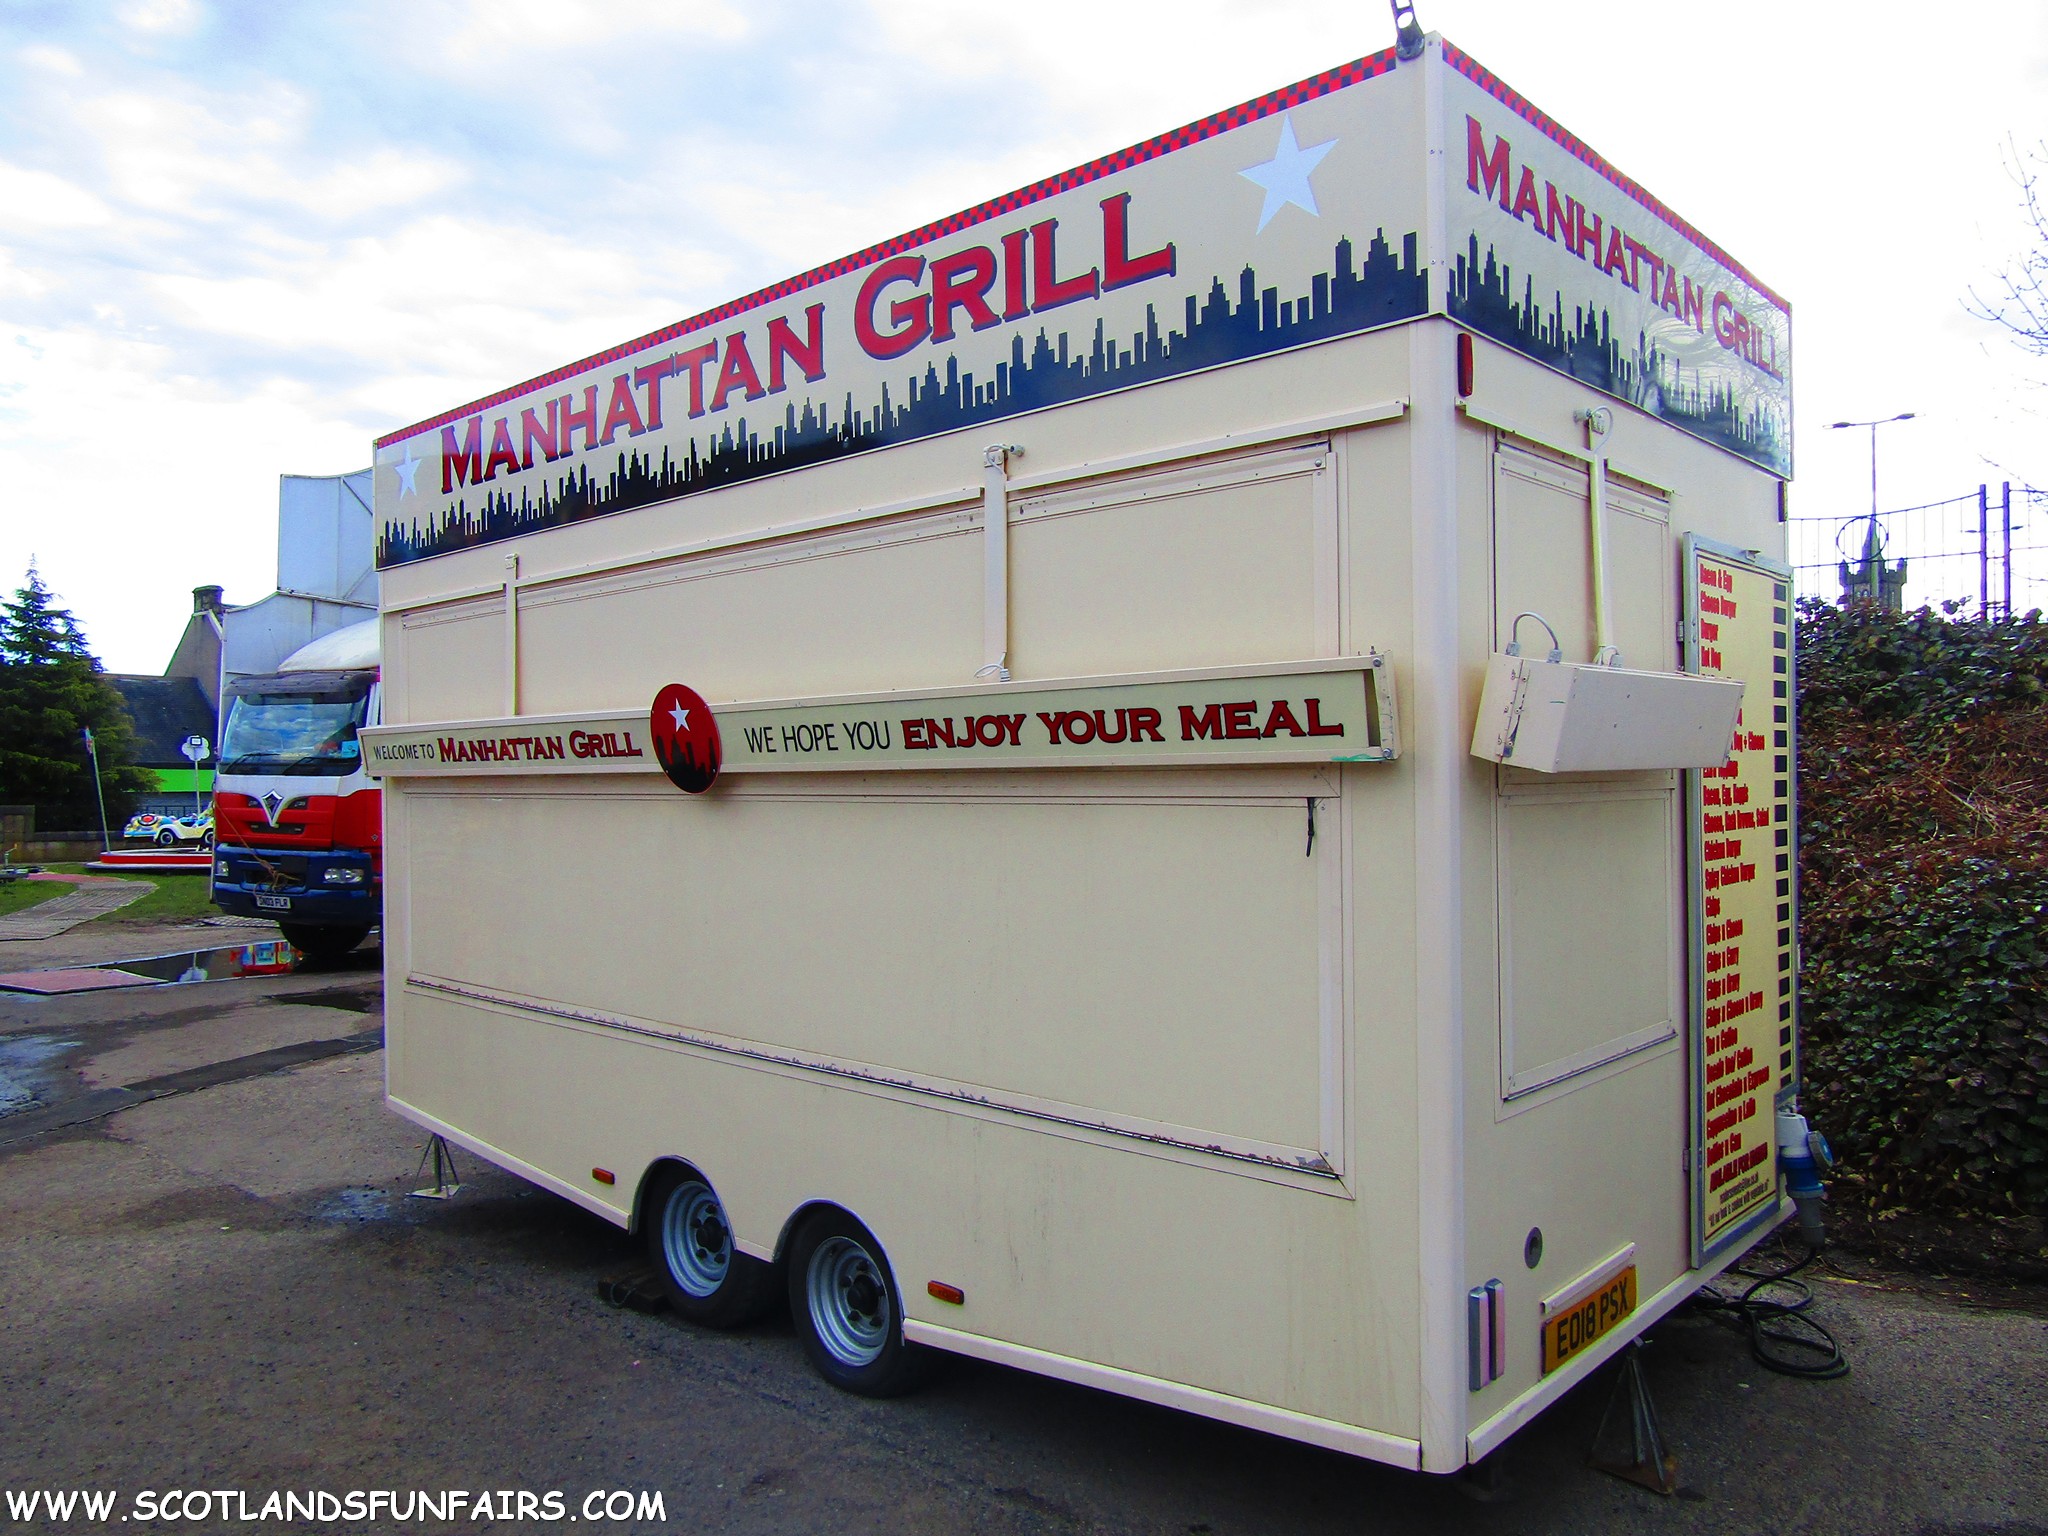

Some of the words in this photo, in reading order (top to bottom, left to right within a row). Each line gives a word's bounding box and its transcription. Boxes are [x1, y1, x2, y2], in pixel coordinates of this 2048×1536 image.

[1465, 113, 1704, 335] MANHATTAN
[1712, 290, 1784, 386] GRILL
[440, 302, 826, 495] MANHATTAN
[853, 191, 1177, 361] GRILL
[1700, 590, 1720, 615] Cheese
[1720, 595, 1737, 620] Burger
[1700, 618, 1719, 643] Burger
[1701, 646, 1710, 668] Hot
[1711, 647, 1722, 672] Dog
[744, 727, 774, 754] WE
[782, 722, 839, 753] HOPE
[842, 720, 890, 751] YOU
[901, 713, 1027, 750] ENJOY
[1036, 706, 1166, 746] YOUR
[1178, 698, 1345, 743] MEAL
[373, 744, 419, 760] WELCOME
[420, 744, 435, 759] TO
[437, 736, 566, 762] MANHATTAN
[569, 730, 643, 758] GRILL
[1726, 838, 1741, 860] Burger
[1740, 862, 1756, 883] Burger
[1600, 1276, 1628, 1330] PSX
